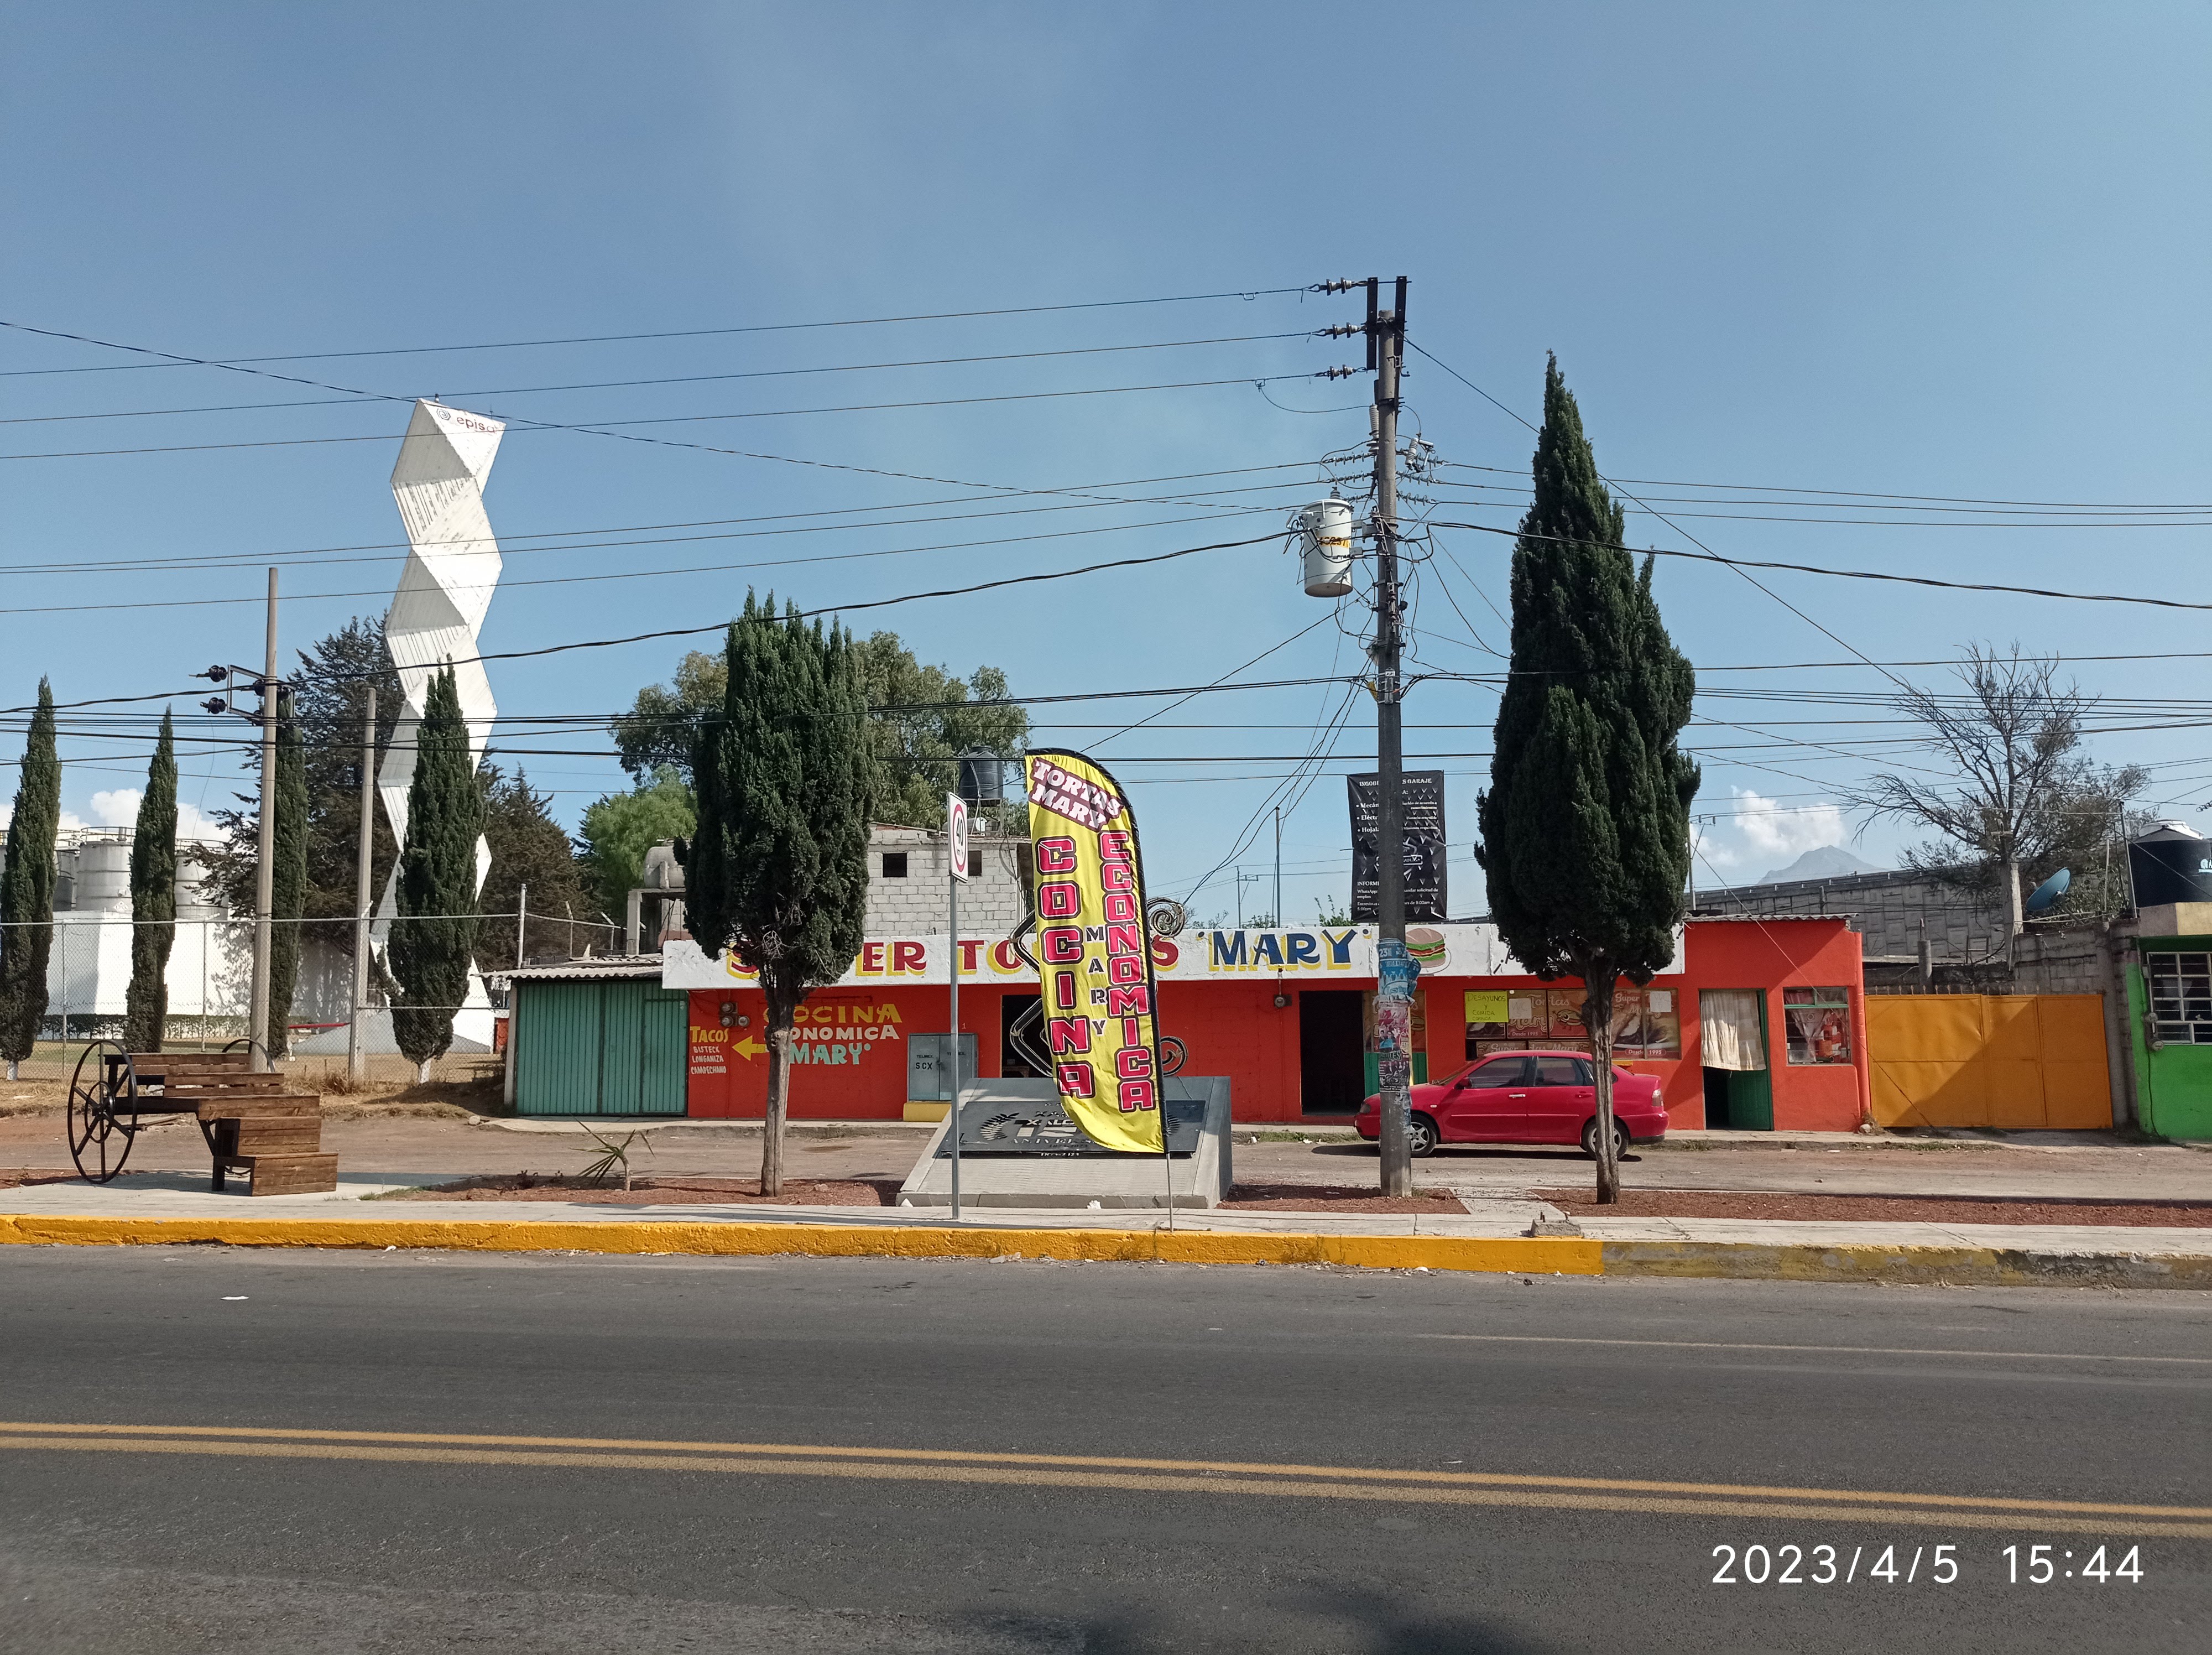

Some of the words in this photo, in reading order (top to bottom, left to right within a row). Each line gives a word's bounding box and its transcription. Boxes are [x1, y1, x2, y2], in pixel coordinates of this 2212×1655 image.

[457, 416, 497, 434] episa
[1034, 761, 1121, 816] TORTAS
[1031, 783, 1107, 829] MARY
[956, 817, 963, 846] 40
[1035, 836, 1095, 1098] COCINA
[1097, 830, 1156, 1113] ECONOMICA
[1084, 925, 1106, 1035] MARY
[1467, 992, 1506, 1002] DESAYUNOS
[1615, 993, 1640, 1003] Super
[690, 1026, 729, 1043] TACOS
[693, 1045, 720, 1053] BISTECK
[692, 1054, 724, 1063] LONGANIZA
[691, 1065, 727, 1075] CAMPECHANO
